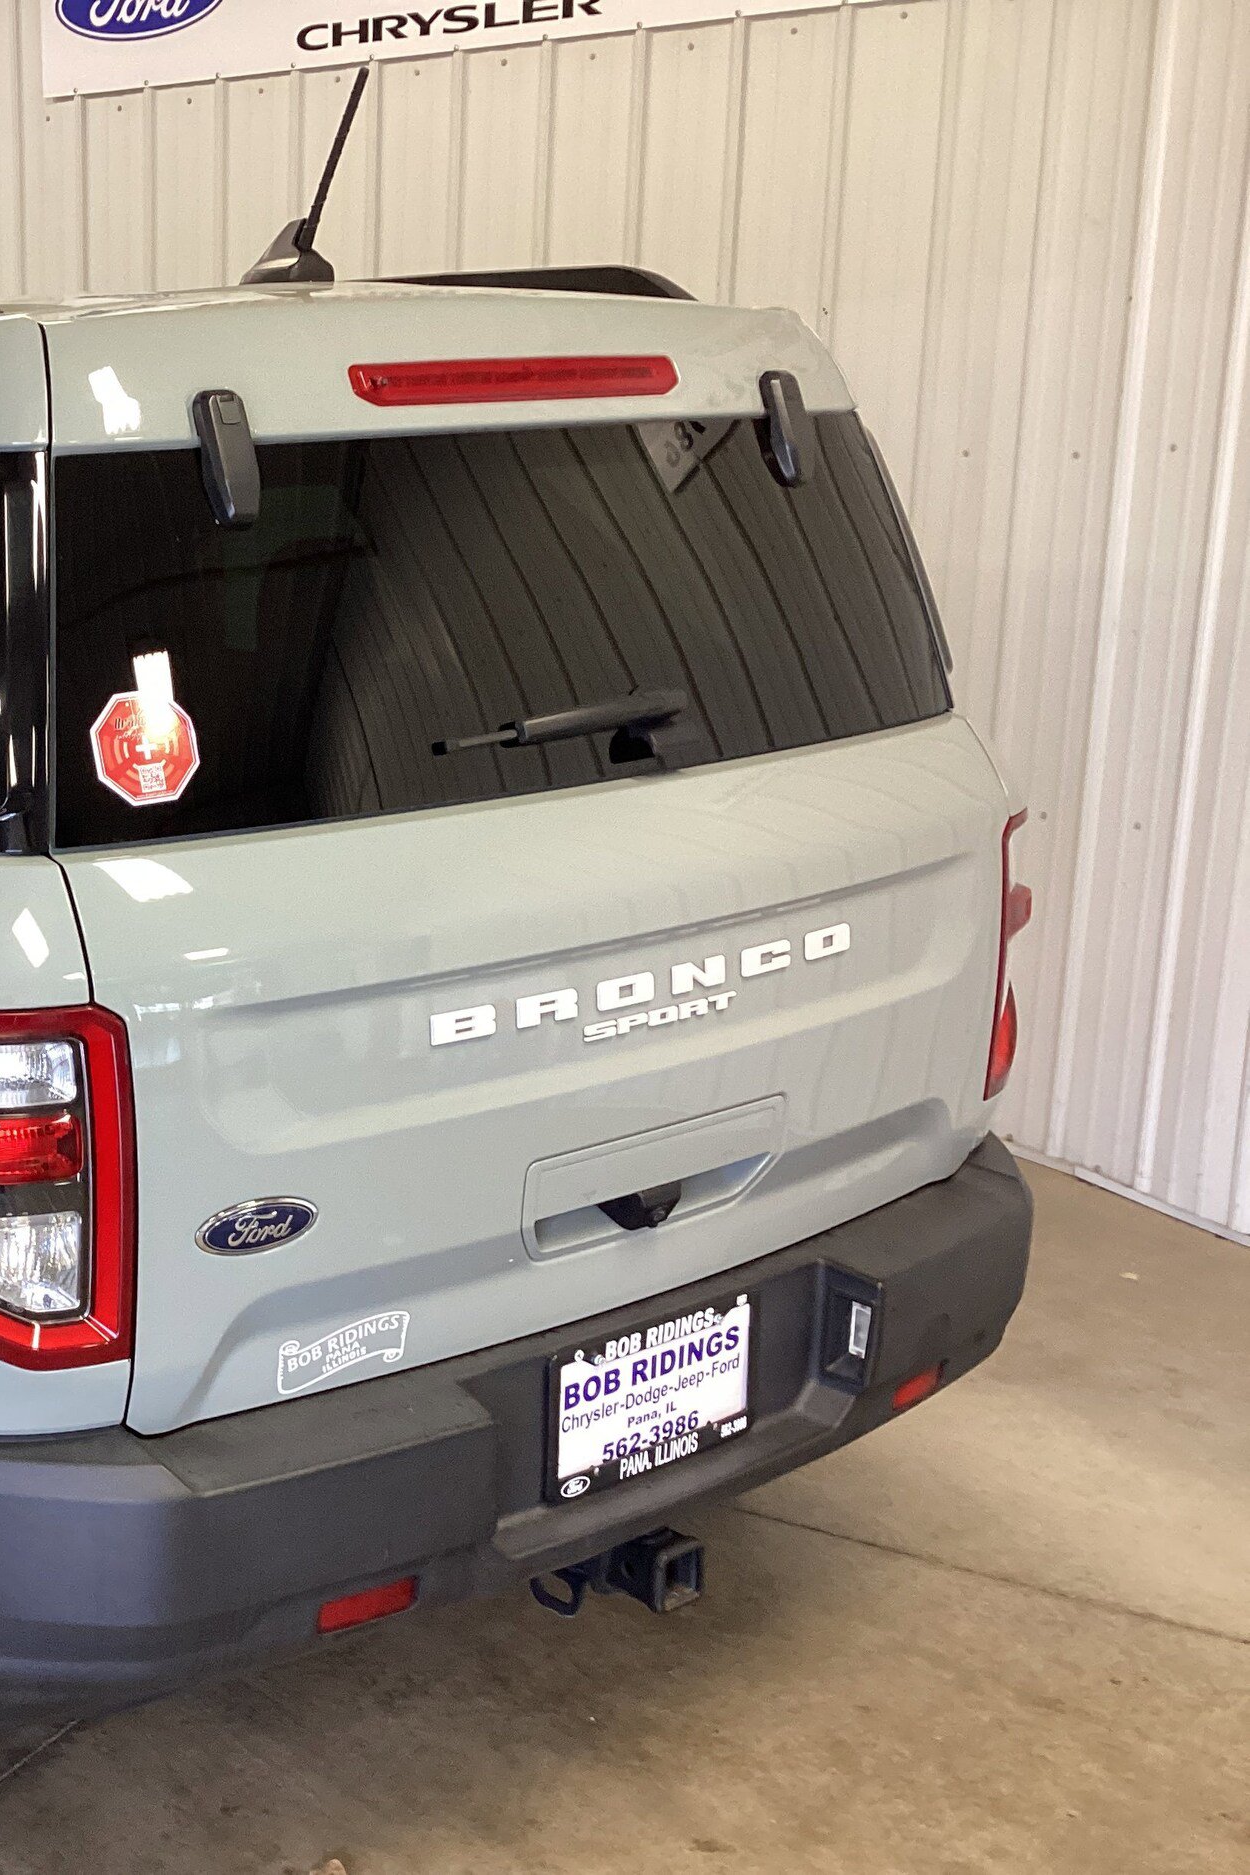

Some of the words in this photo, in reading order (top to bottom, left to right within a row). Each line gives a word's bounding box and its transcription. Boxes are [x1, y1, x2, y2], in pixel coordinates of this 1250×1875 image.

[296, 0, 603, 51] CHRYSLER
[430, 922, 850, 1046] BRONCO
[583, 990, 737, 1042] SPORT
[227, 1210, 293, 1247] Ford
[287, 1345, 322, 1372] BOB
[327, 1315, 400, 1352] RIDINGS
[321, 1346, 367, 1373] ILLINOIS
[326, 1341, 360, 1363] PANA
[605, 1332, 642, 1361] BOB
[646, 1307, 714, 1348] RIDINGS
[564, 1368, 621, 1411] BOB
[631, 1326, 740, 1386] RIDINGS
[602, 1410, 699, 1463] 562-3986
[627, 1410, 662, 1428] Pana,
[666, 1401, 677, 1413] IL
[655, 1432, 698, 1467] ILLINOIS
